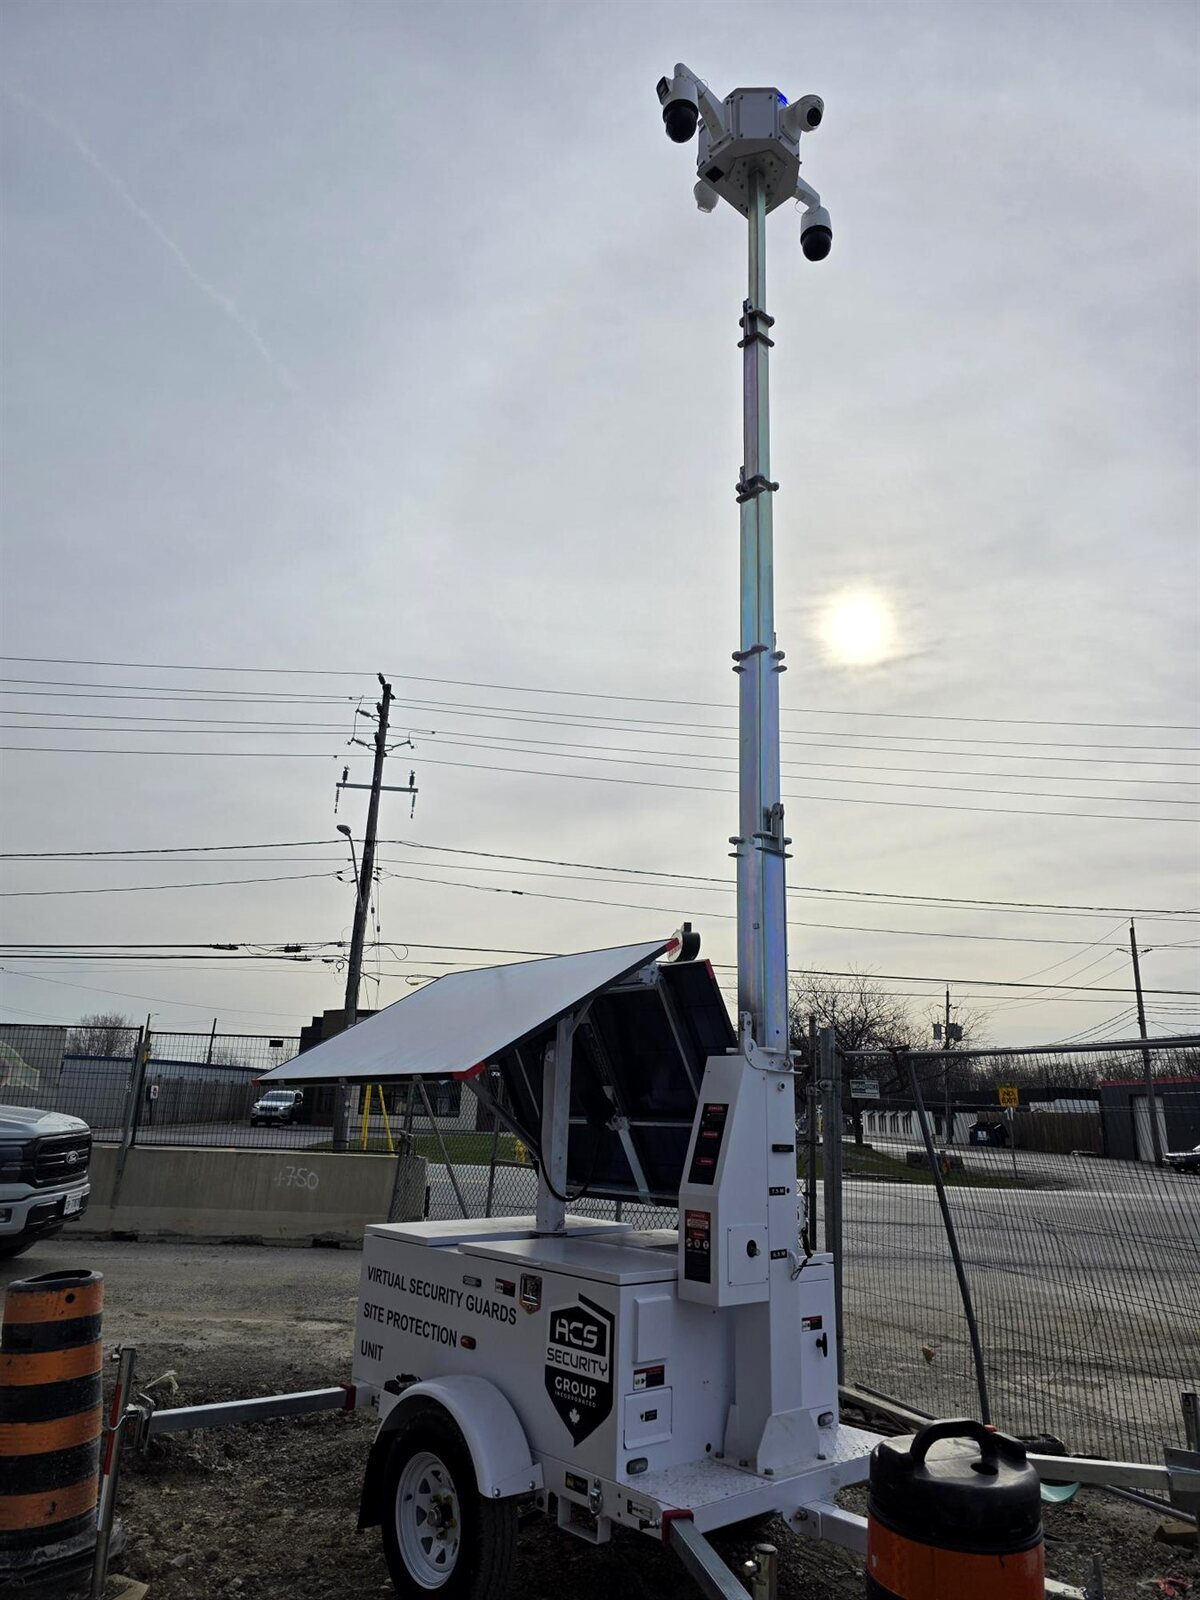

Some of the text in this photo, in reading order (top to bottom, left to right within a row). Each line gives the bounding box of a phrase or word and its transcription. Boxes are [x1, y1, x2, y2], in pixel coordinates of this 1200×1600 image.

[367, 1265, 407, 1292] VIRTUAL
[409, 1278, 464, 1308] SECURITY
[465, 1294, 517, 1325] GUARDS
[363, 1302, 458, 1348] SITE PROTECTION
[554, 1317, 598, 1349] ACS
[360, 1339, 384, 1361] UNIT
[546, 1347, 608, 1376] SECURITY
[554, 1375, 597, 1400] GROUP
[554, 1390, 598, 1409] INCORPORATED
